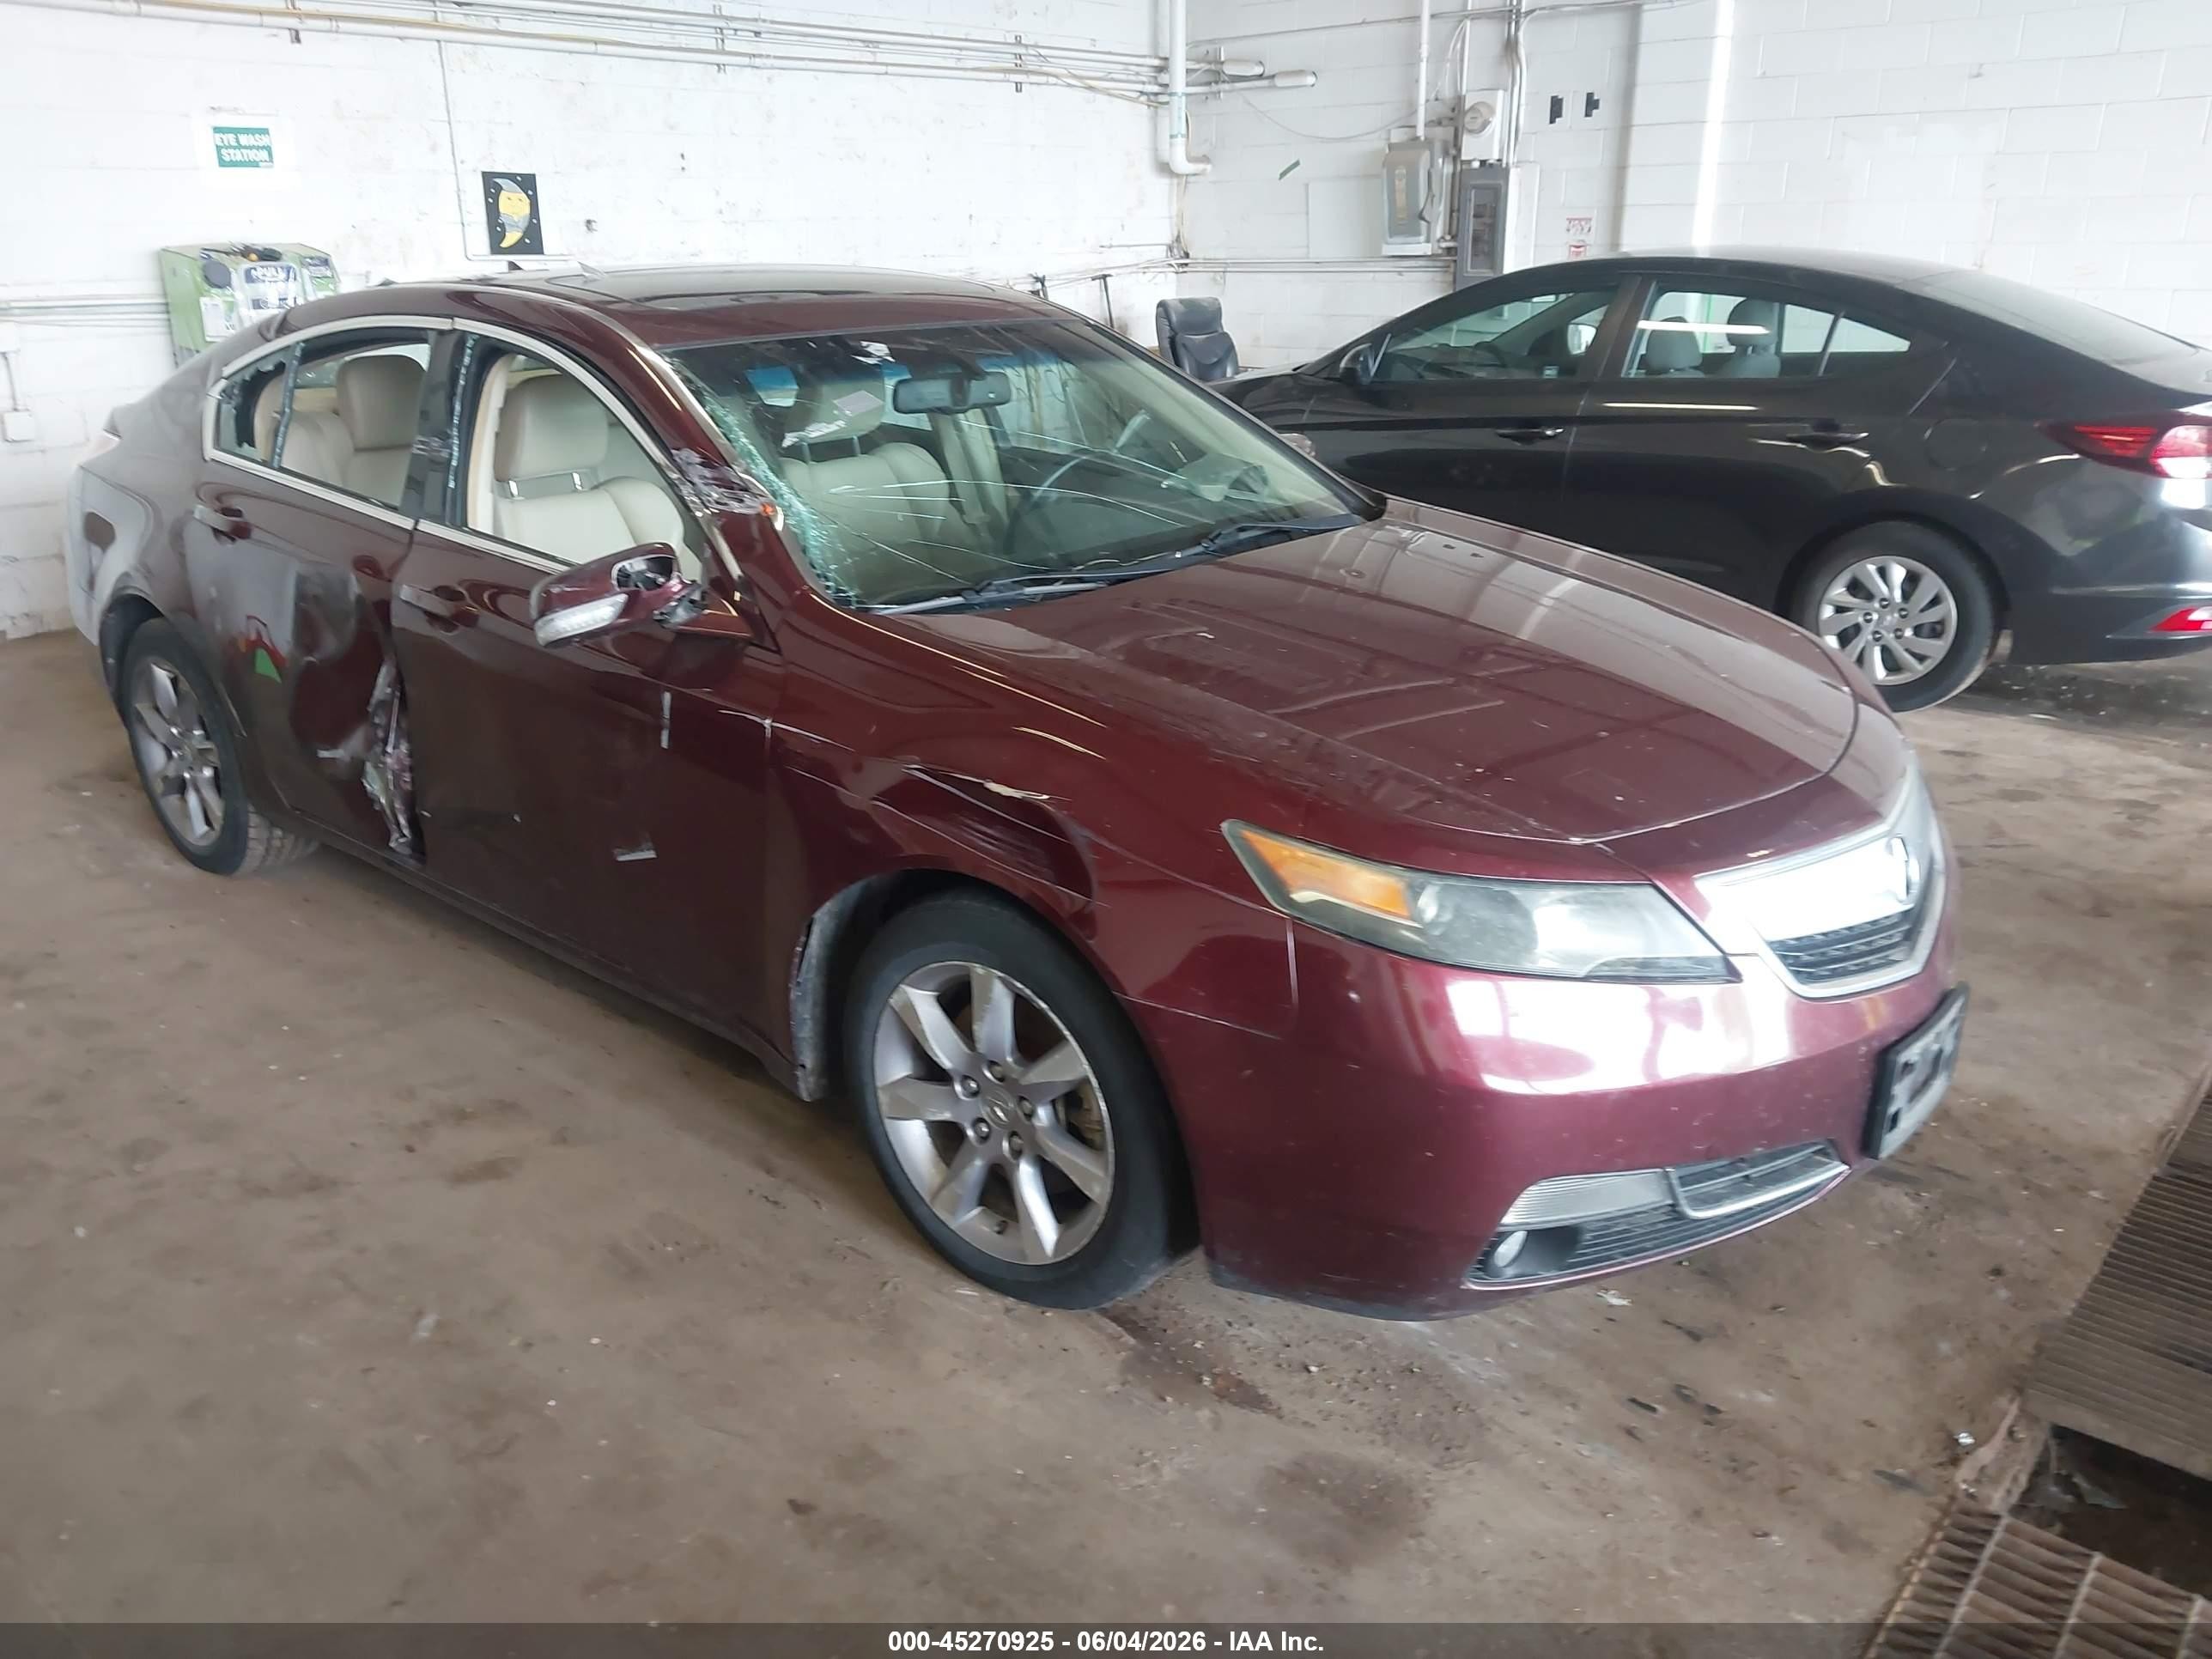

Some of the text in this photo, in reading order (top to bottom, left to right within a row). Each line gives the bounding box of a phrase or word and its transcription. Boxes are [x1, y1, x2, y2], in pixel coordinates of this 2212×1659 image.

[214, 133, 271, 147] EYE WASH
[221, 149, 270, 161] STATION
